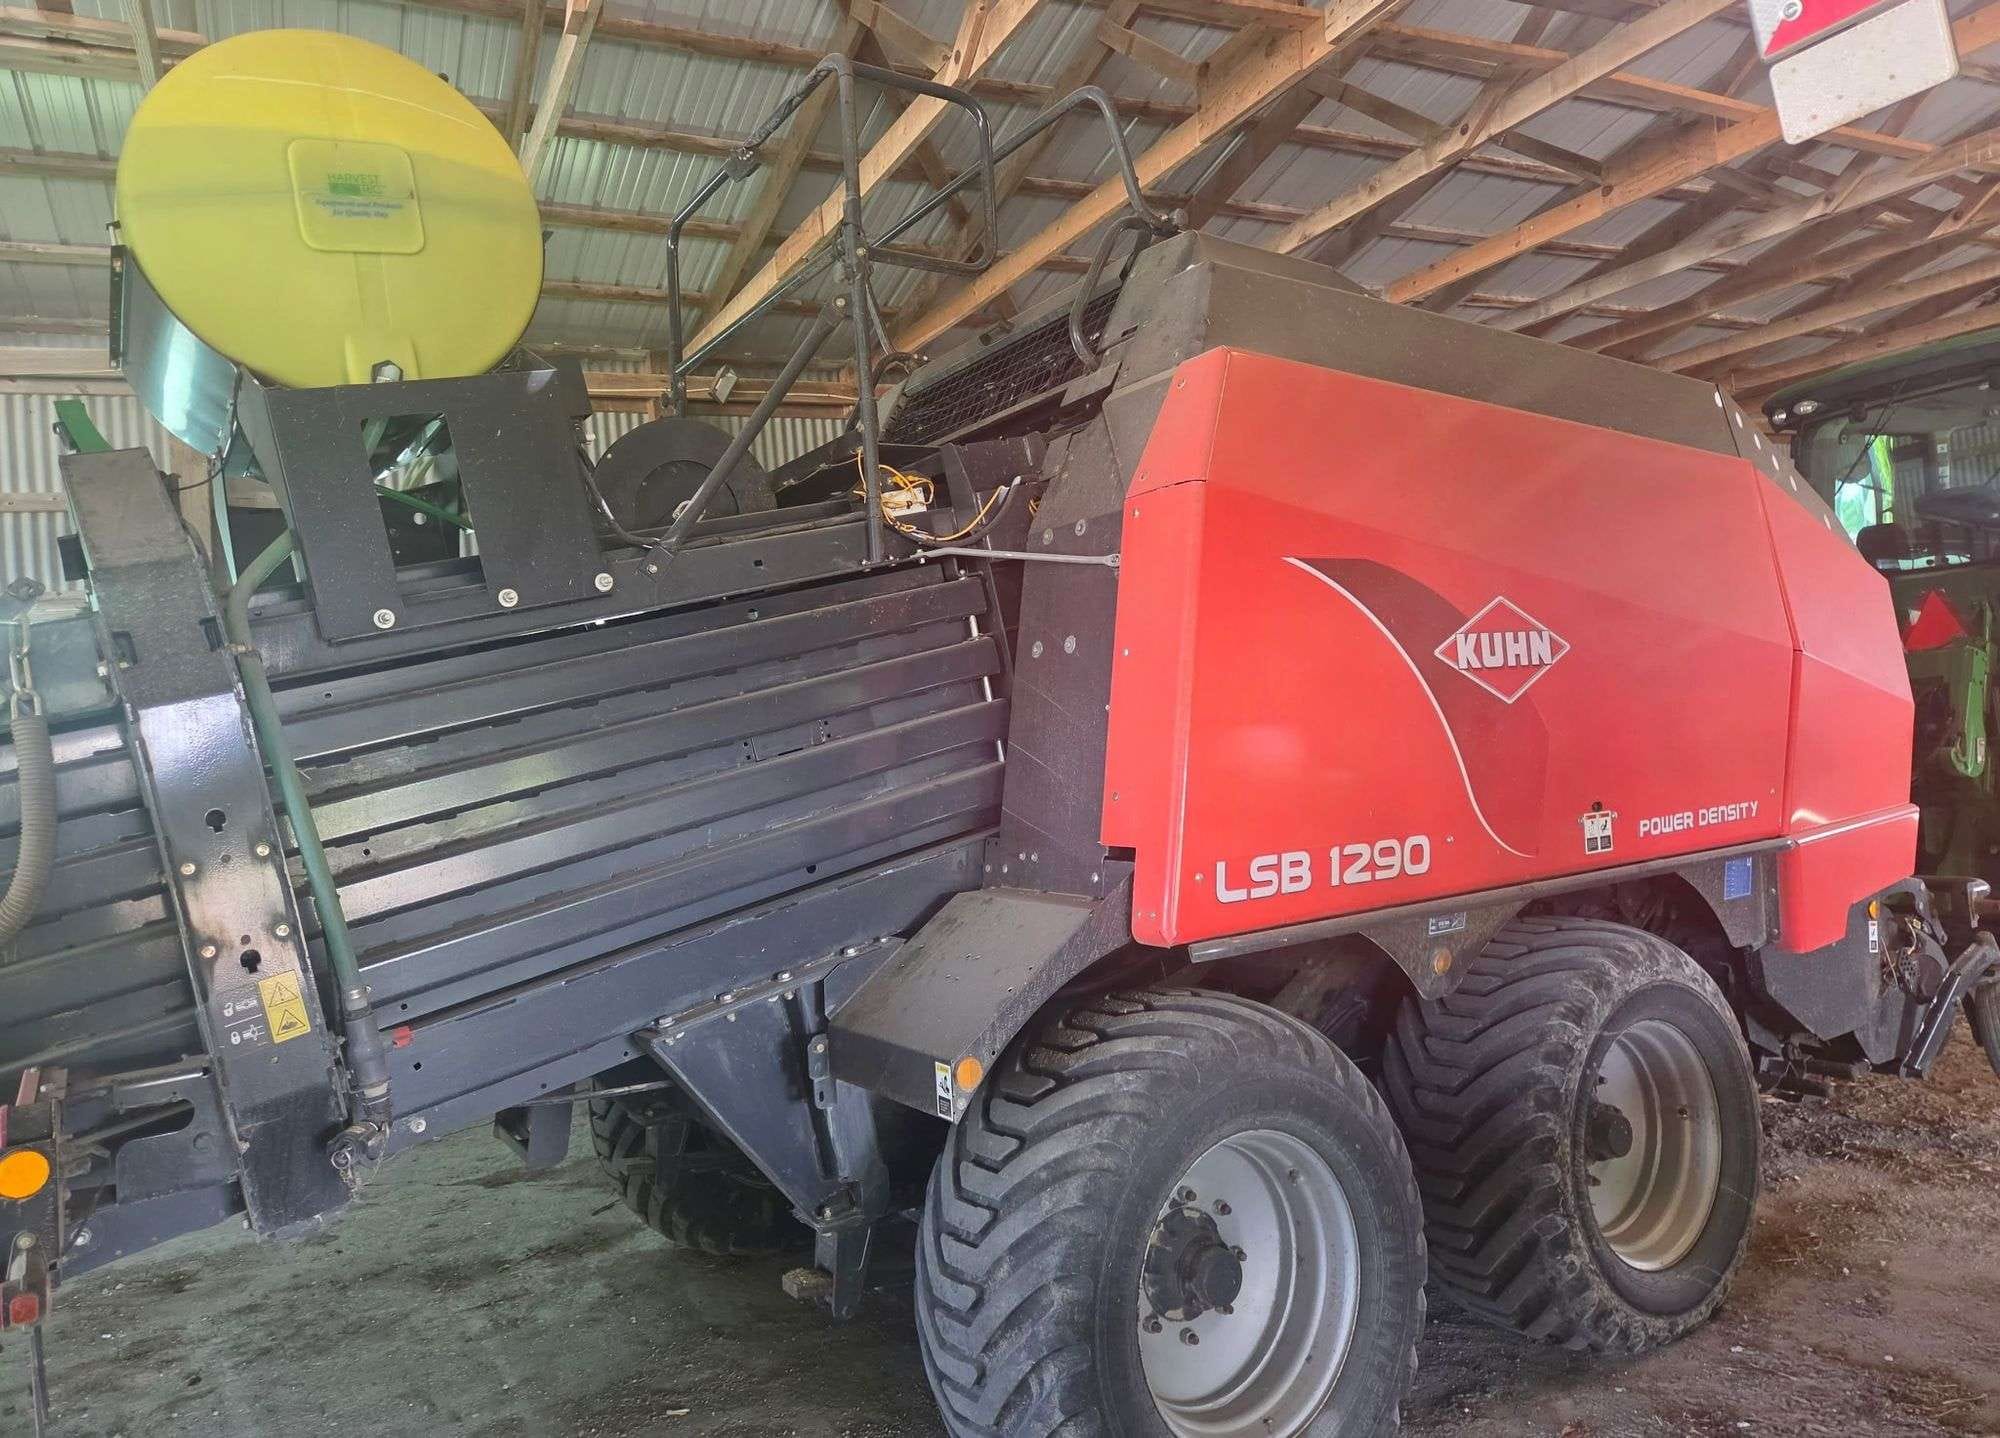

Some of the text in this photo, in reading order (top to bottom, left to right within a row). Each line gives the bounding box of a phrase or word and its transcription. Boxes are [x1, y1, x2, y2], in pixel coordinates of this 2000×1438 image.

[1456, 630, 1552, 669] KUHN
[1639, 800, 1759, 838] POWER DENSITY
[1215, 834, 1431, 904] LSB 1290
